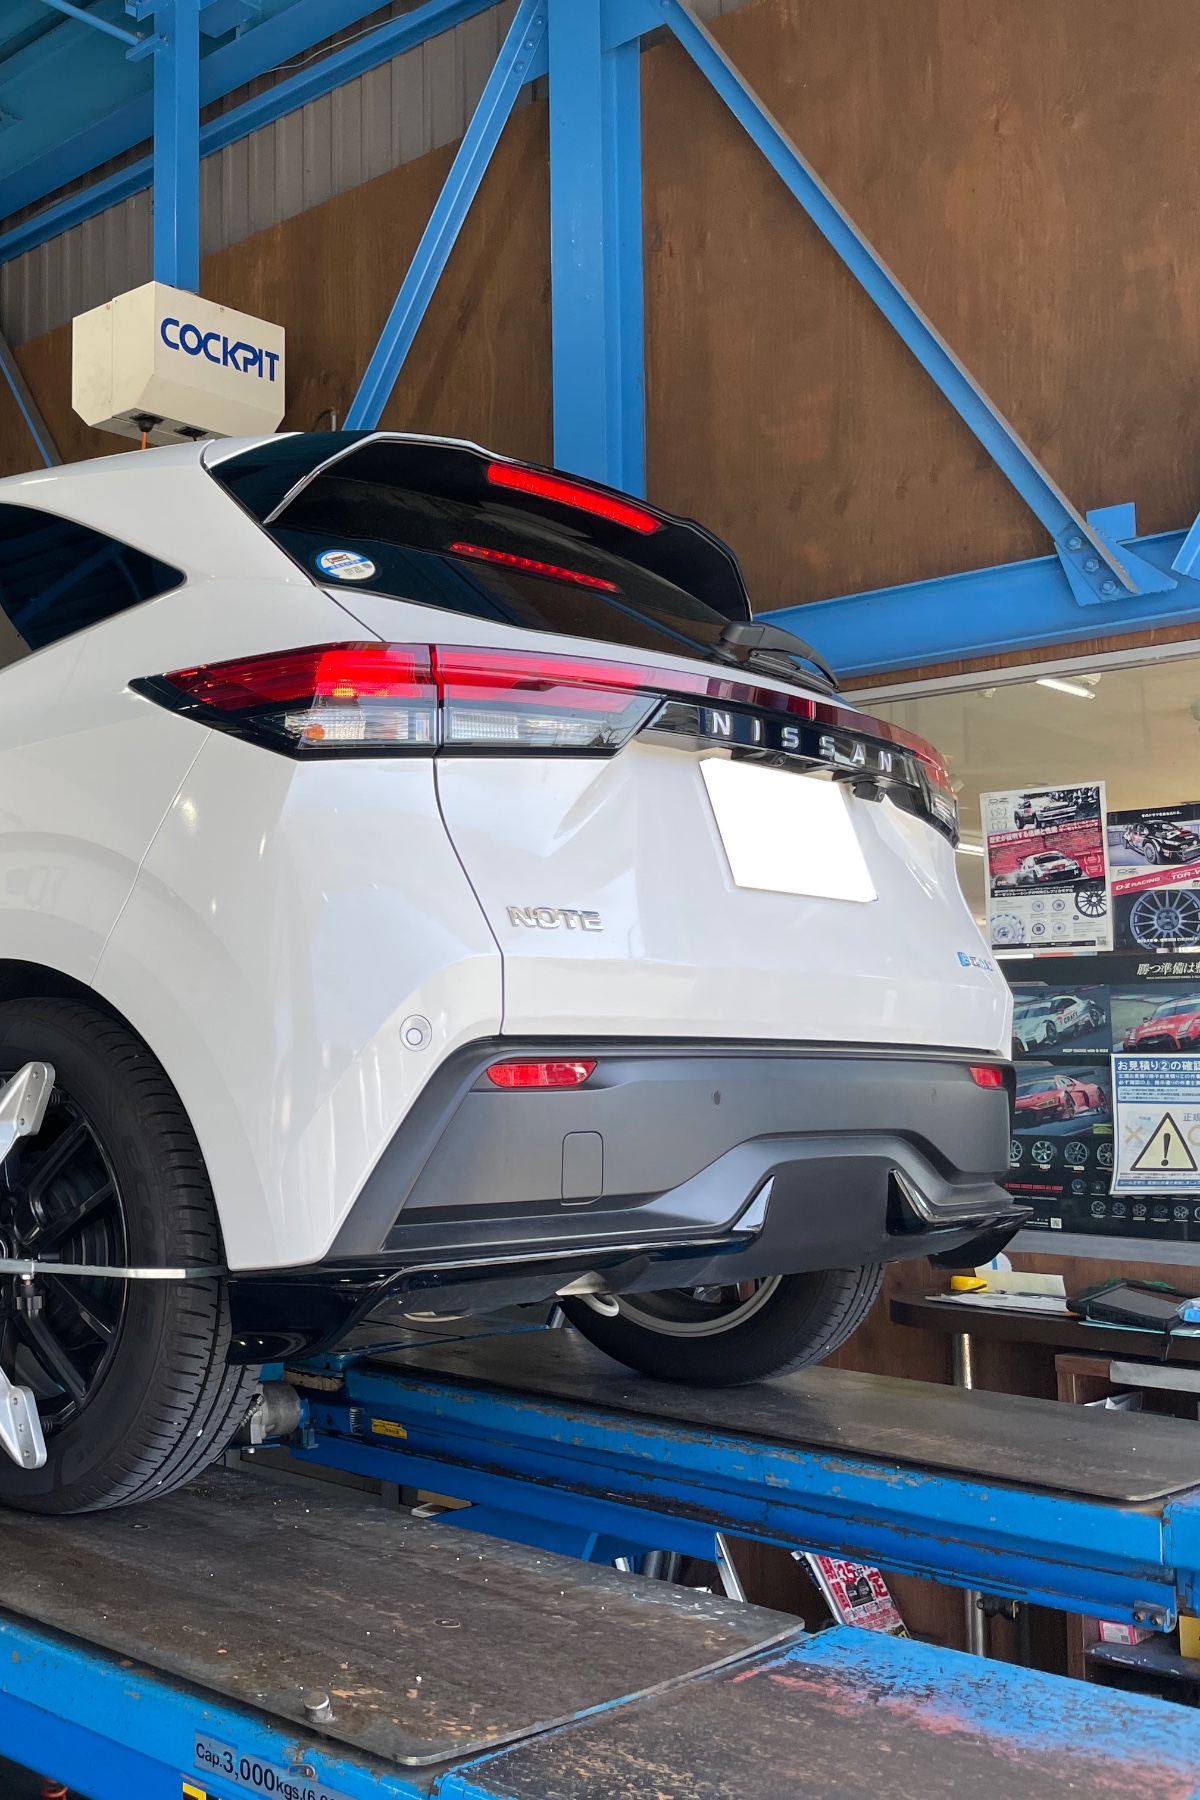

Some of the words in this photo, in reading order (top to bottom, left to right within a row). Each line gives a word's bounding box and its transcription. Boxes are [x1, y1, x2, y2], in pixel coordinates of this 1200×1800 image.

[160, 317, 280, 382] COCKPIT
[710, 711, 894, 774] NISSAN
[1131, 876, 1161, 888] RACING
[505, 905, 605, 932] NOTE
